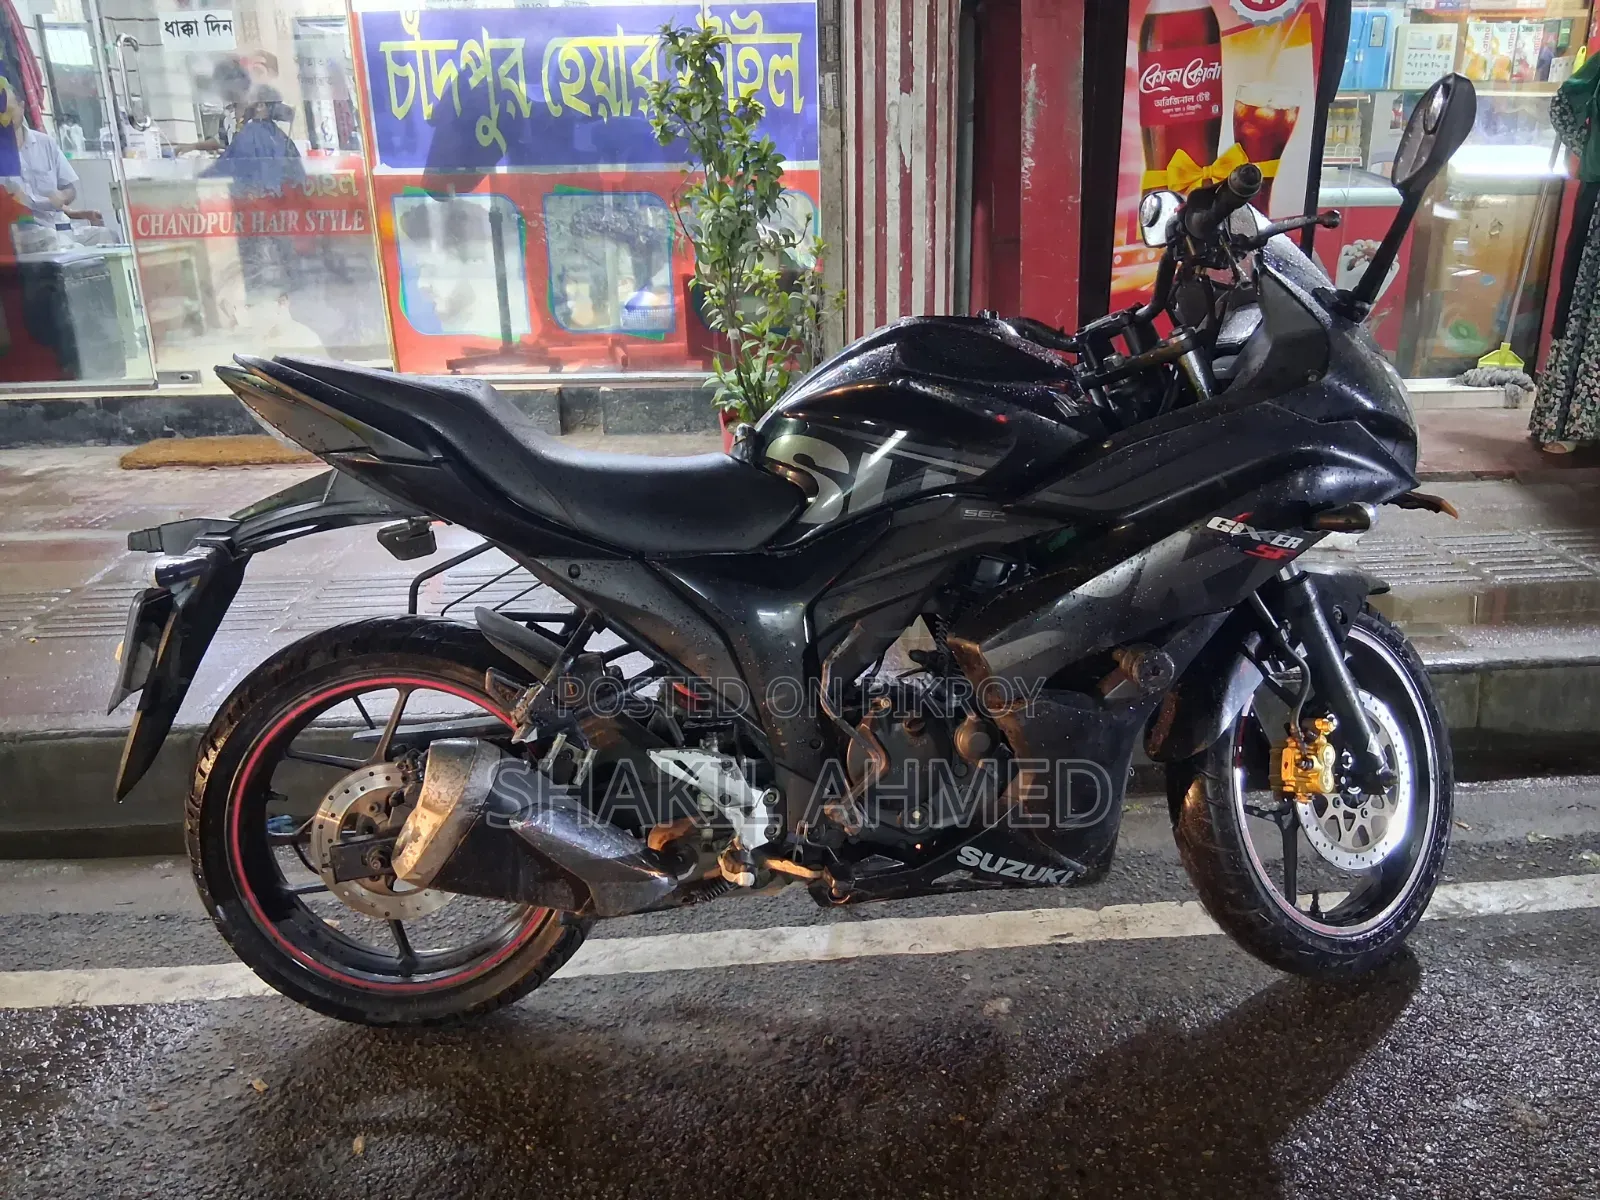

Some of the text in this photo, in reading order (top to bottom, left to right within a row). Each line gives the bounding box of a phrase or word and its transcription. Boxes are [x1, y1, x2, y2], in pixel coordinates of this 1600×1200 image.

[164, 14, 233, 38] ধাক্কা দিন
[380, 8, 532, 155] চাঁদপুর
[542, 24, 661, 123] হেয়ার
[137, 208, 365, 237] CHANDPUR HAIR STYLE
[956, 845, 1075, 884] SUZUKI
